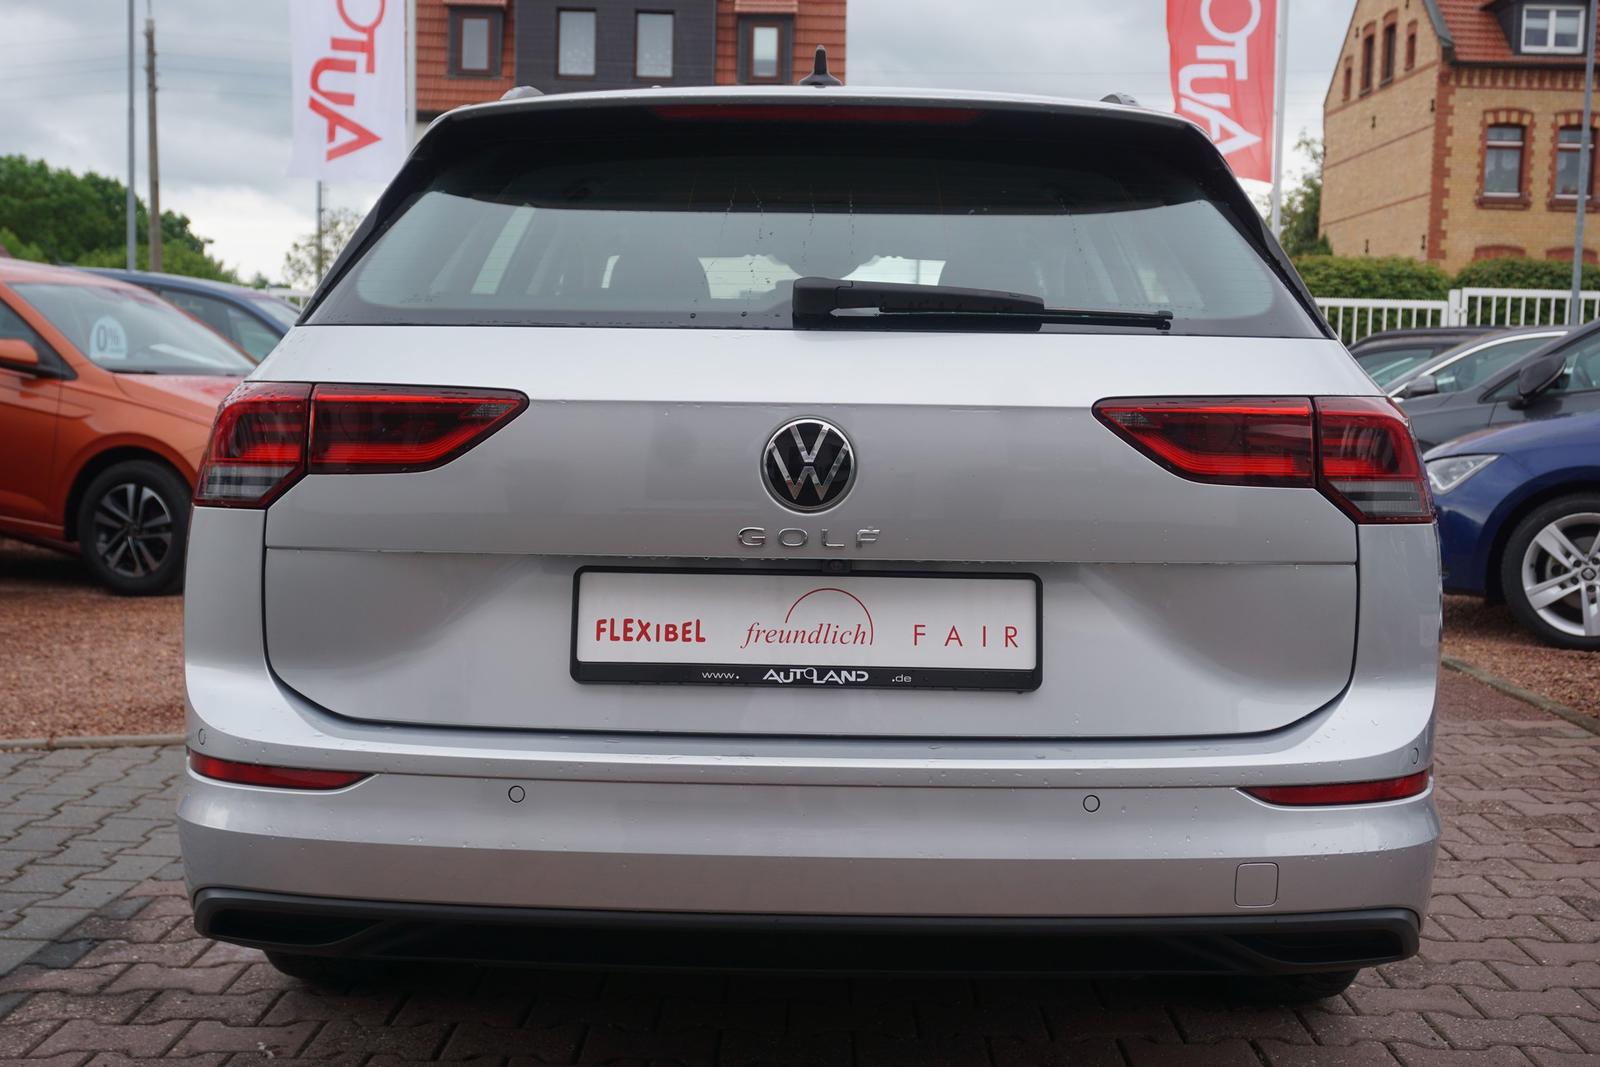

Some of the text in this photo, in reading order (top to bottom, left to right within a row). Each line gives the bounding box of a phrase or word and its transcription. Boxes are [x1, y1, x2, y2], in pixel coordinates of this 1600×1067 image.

[738, 526, 880, 548] GOLF
[595, 617, 1018, 649] FLEXIBEL freundlich FAIR
[701, 667, 912, 685] www. AUTOLAND .de
